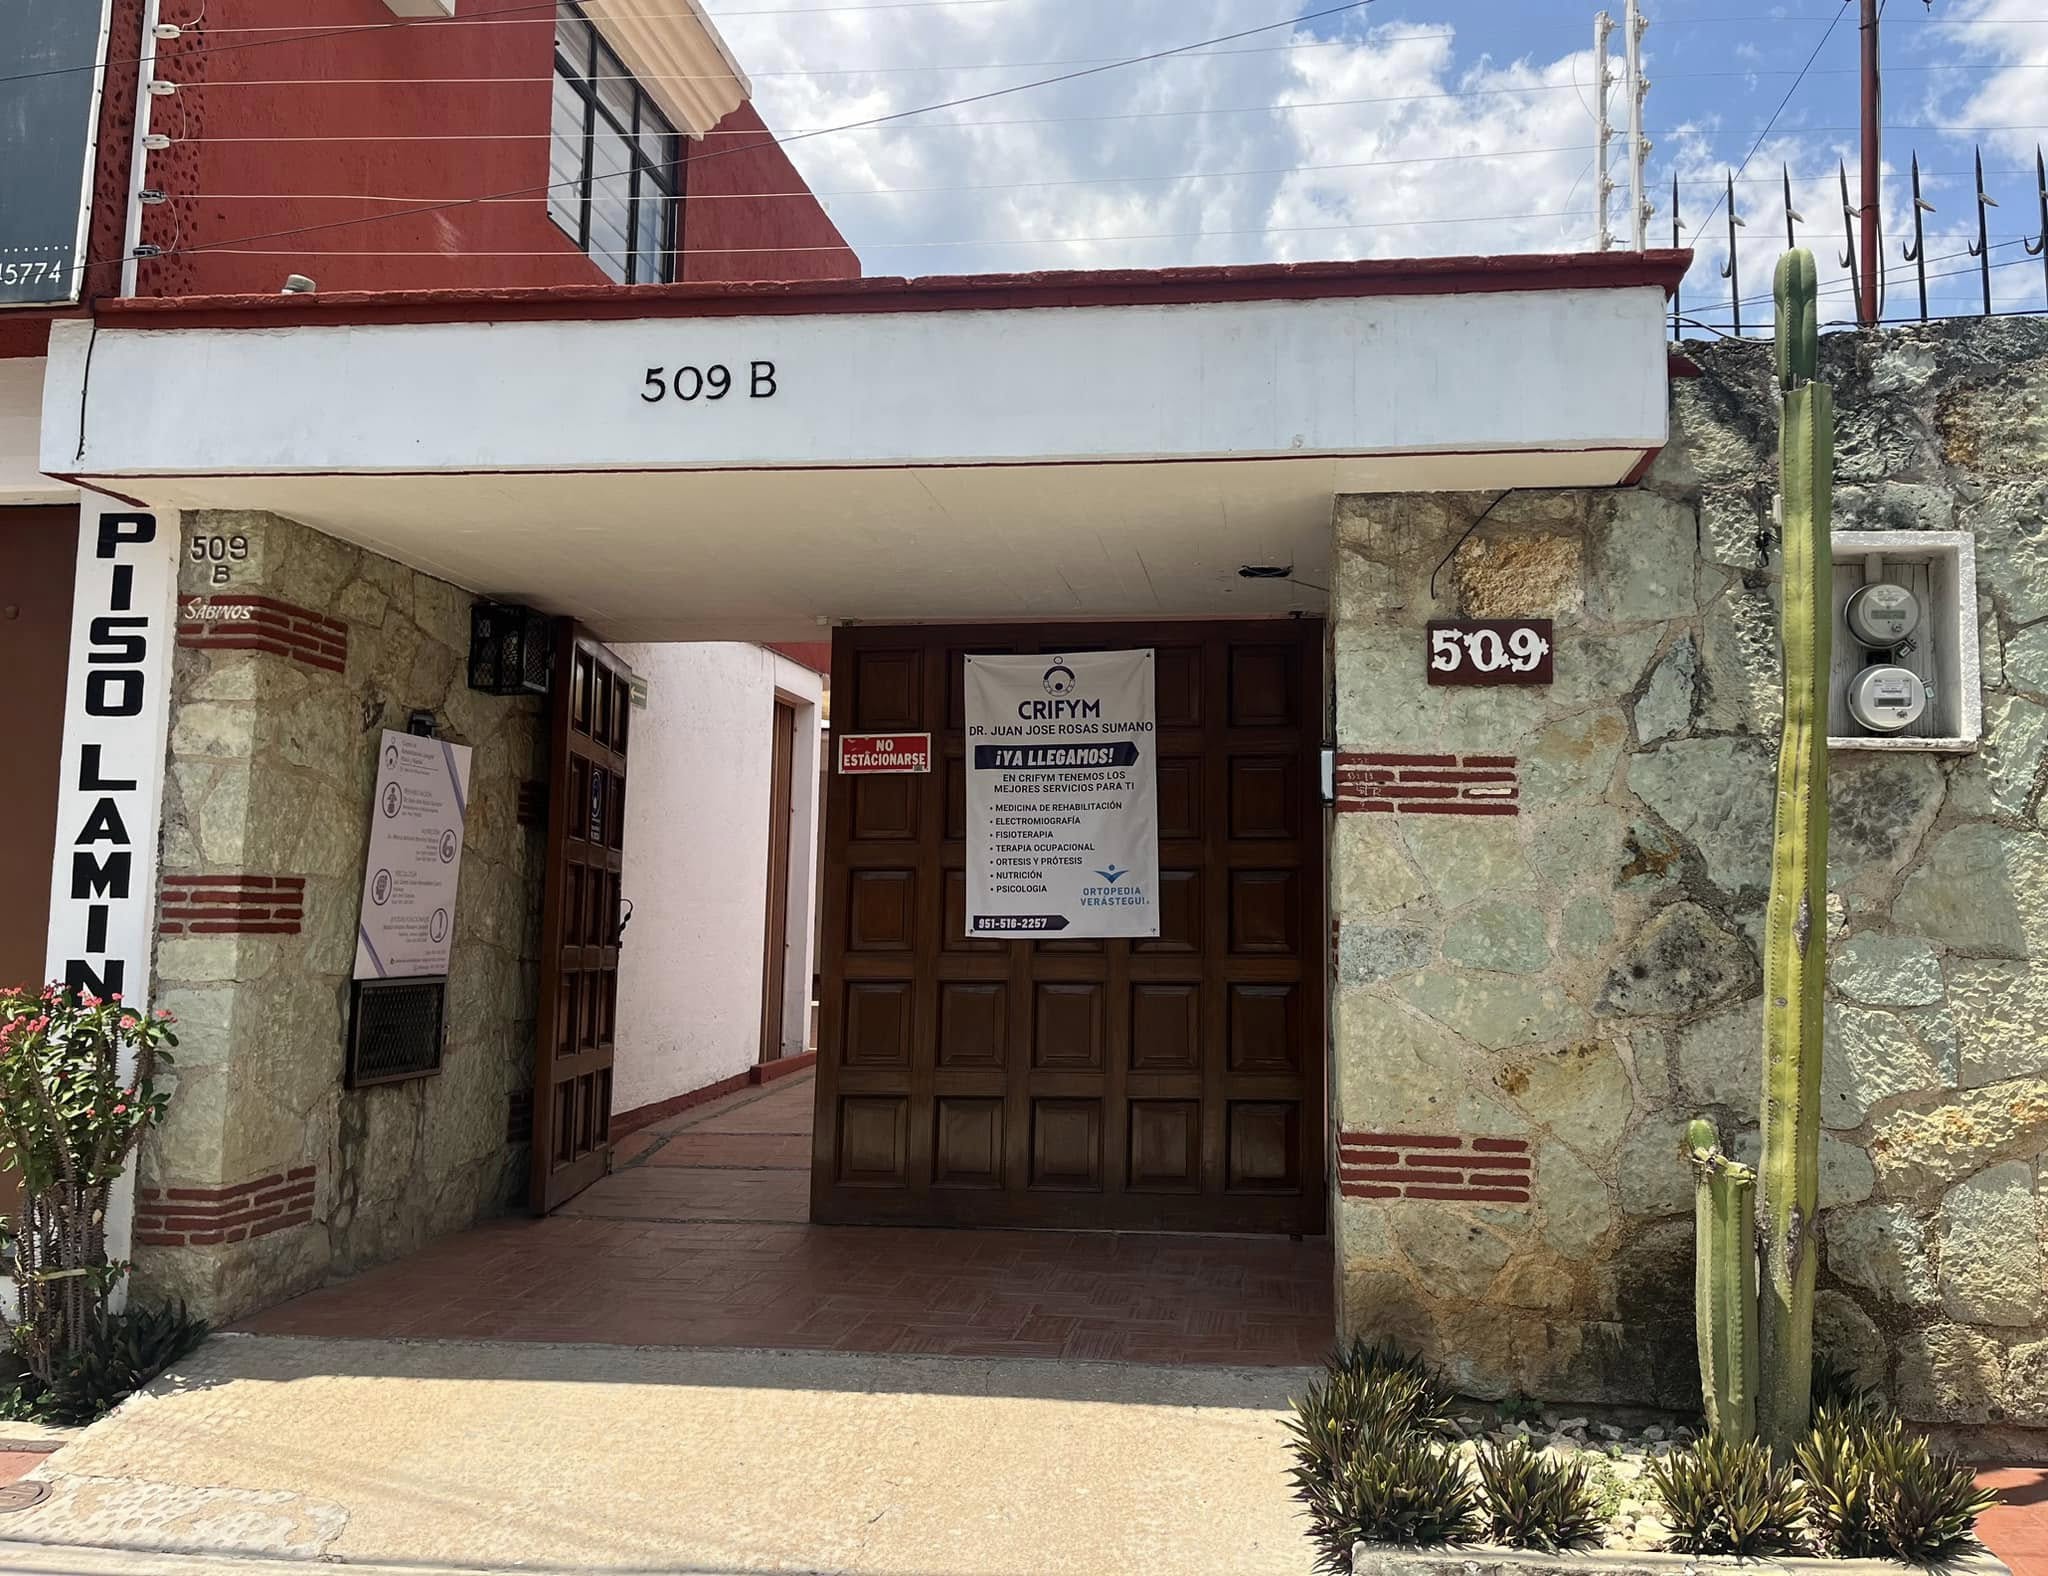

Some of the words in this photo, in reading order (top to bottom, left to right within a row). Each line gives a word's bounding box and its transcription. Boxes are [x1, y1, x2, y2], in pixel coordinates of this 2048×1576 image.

[0, 260, 61, 285] 5774
[641, 364, 731, 402] 509
[749, 361, 777, 398] B
[190, 535, 248, 563] 509
[211, 564, 231, 586] B
[85, 512, 156, 717] PISO
[1431, 628, 1549, 672] 509
[1018, 699, 1100, 720] CRIFYM
[969, 726, 987, 736] DR.
[990, 725, 1023, 736] JUAN
[1025, 724, 1055, 736] JOSE
[1058, 723, 1099, 735] ROSAS
[1102, 721, 1153, 733] SUMANO
[876, 739, 894, 752] NO
[843, 753, 926, 767] ESTACIONARSE
[995, 750, 1023, 767] ¡YA
[1027, 747, 1114, 766] LLEGAMOS!
[1003, 774, 1016, 782] EN
[1018, 773, 1056, 782] CRIFYM
[1058, 772, 1105, 782] TENEMOS
[1106, 771, 1126, 780] LOS
[994, 785, 1040, 793] MEJORES
[1042, 784, 1094, 793] SERVICIOS
[1096, 782, 1122, 791] PARA
[1124, 782, 1135, 790] TI
[995, 803, 1037, 812] MEDICINA
[1039, 803, 1051, 812] DE
[1052, 802, 1122, 811] REHABILITACIÓN
[995, 815, 1081, 825] ELECTROMIOGRAFÍA
[995, 830, 1054, 839] FISIOTERAPIA
[996, 844, 1032, 852] TERAPIA
[1034, 843, 1095, 852] OCUPACIONAL
[996, 858, 1032, 866] ORTESIS
[1033, 857, 1039, 865] Y
[1040, 856, 1083, 865] PRÓTESIS
[996, 870, 1043, 879] NUTRICIÓN
[1083, 887, 1141, 896] ORTOPEDIA
